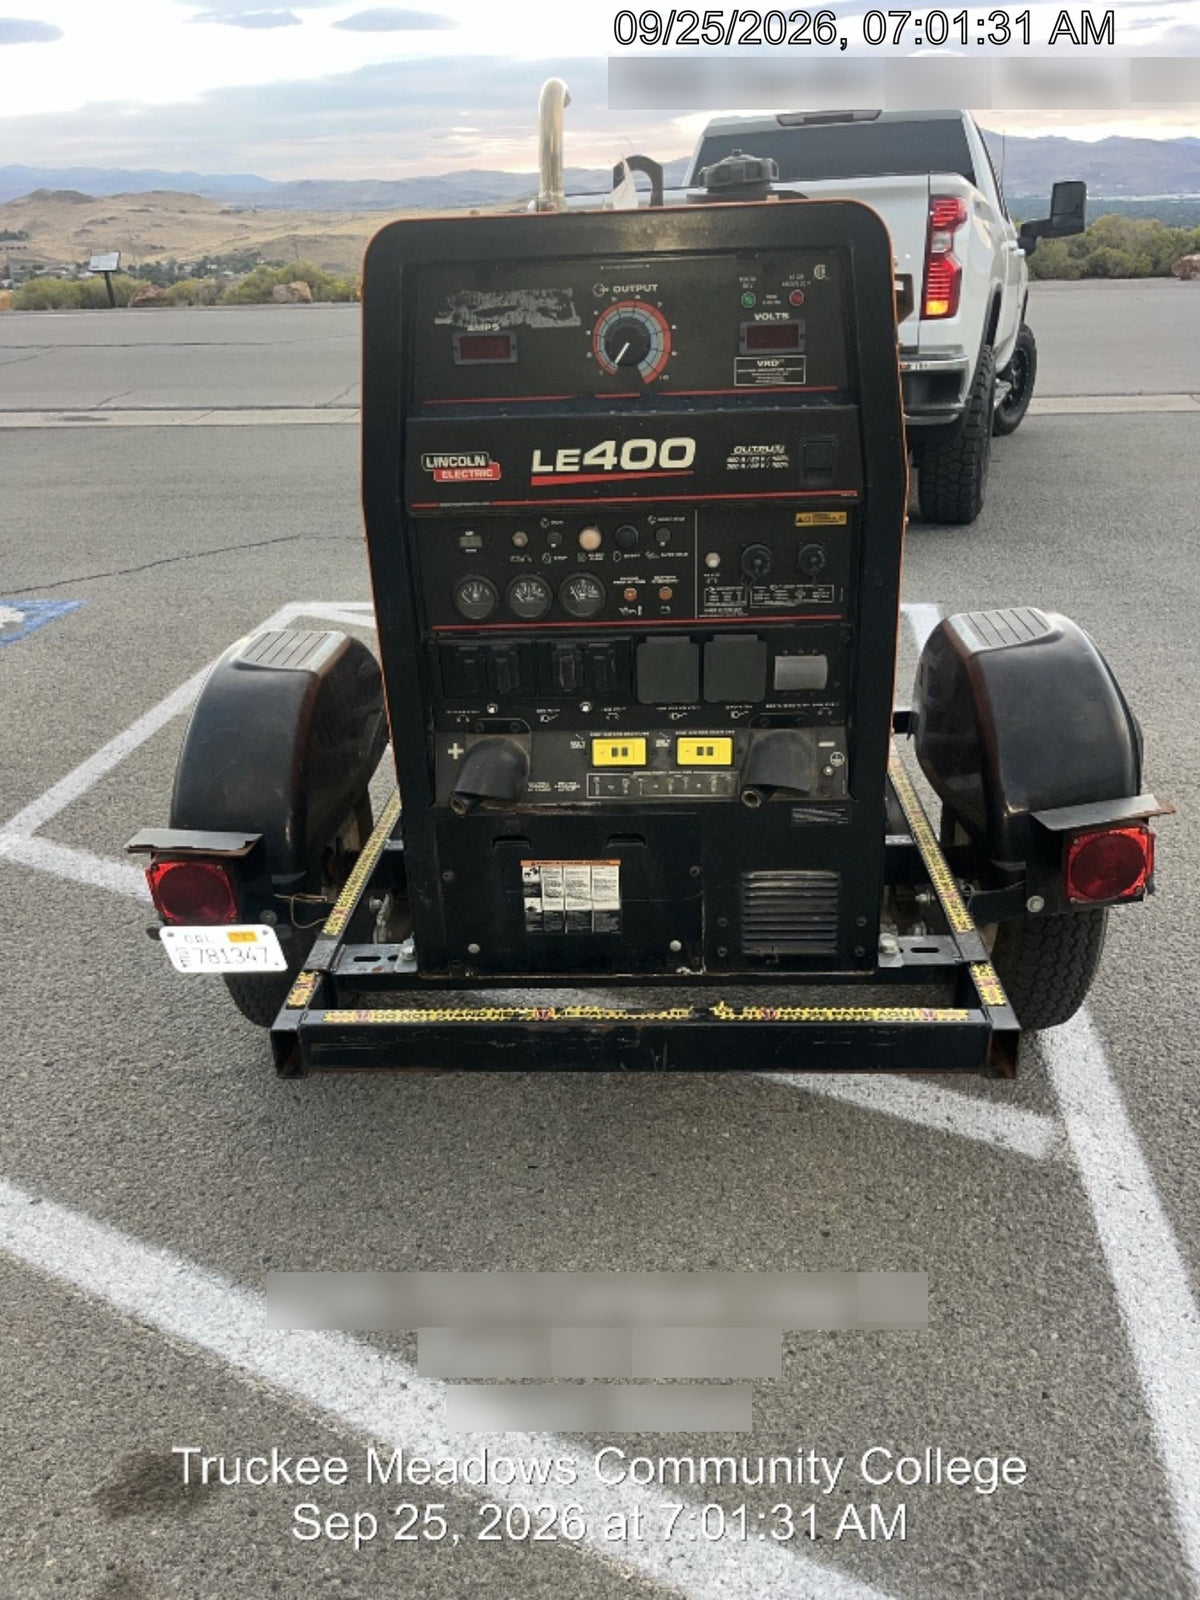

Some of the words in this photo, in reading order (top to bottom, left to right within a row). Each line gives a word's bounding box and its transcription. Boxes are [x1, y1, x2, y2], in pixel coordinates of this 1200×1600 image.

[612, 284, 658, 293] OUTPUT
[754, 312, 790, 321] VOLTS
[530, 437, 697, 473] LE400
[426, 455, 486, 468] LINCOLN
[441, 468, 494, 479] ELECTRIC
[374, 1012, 396, 1020] DO
